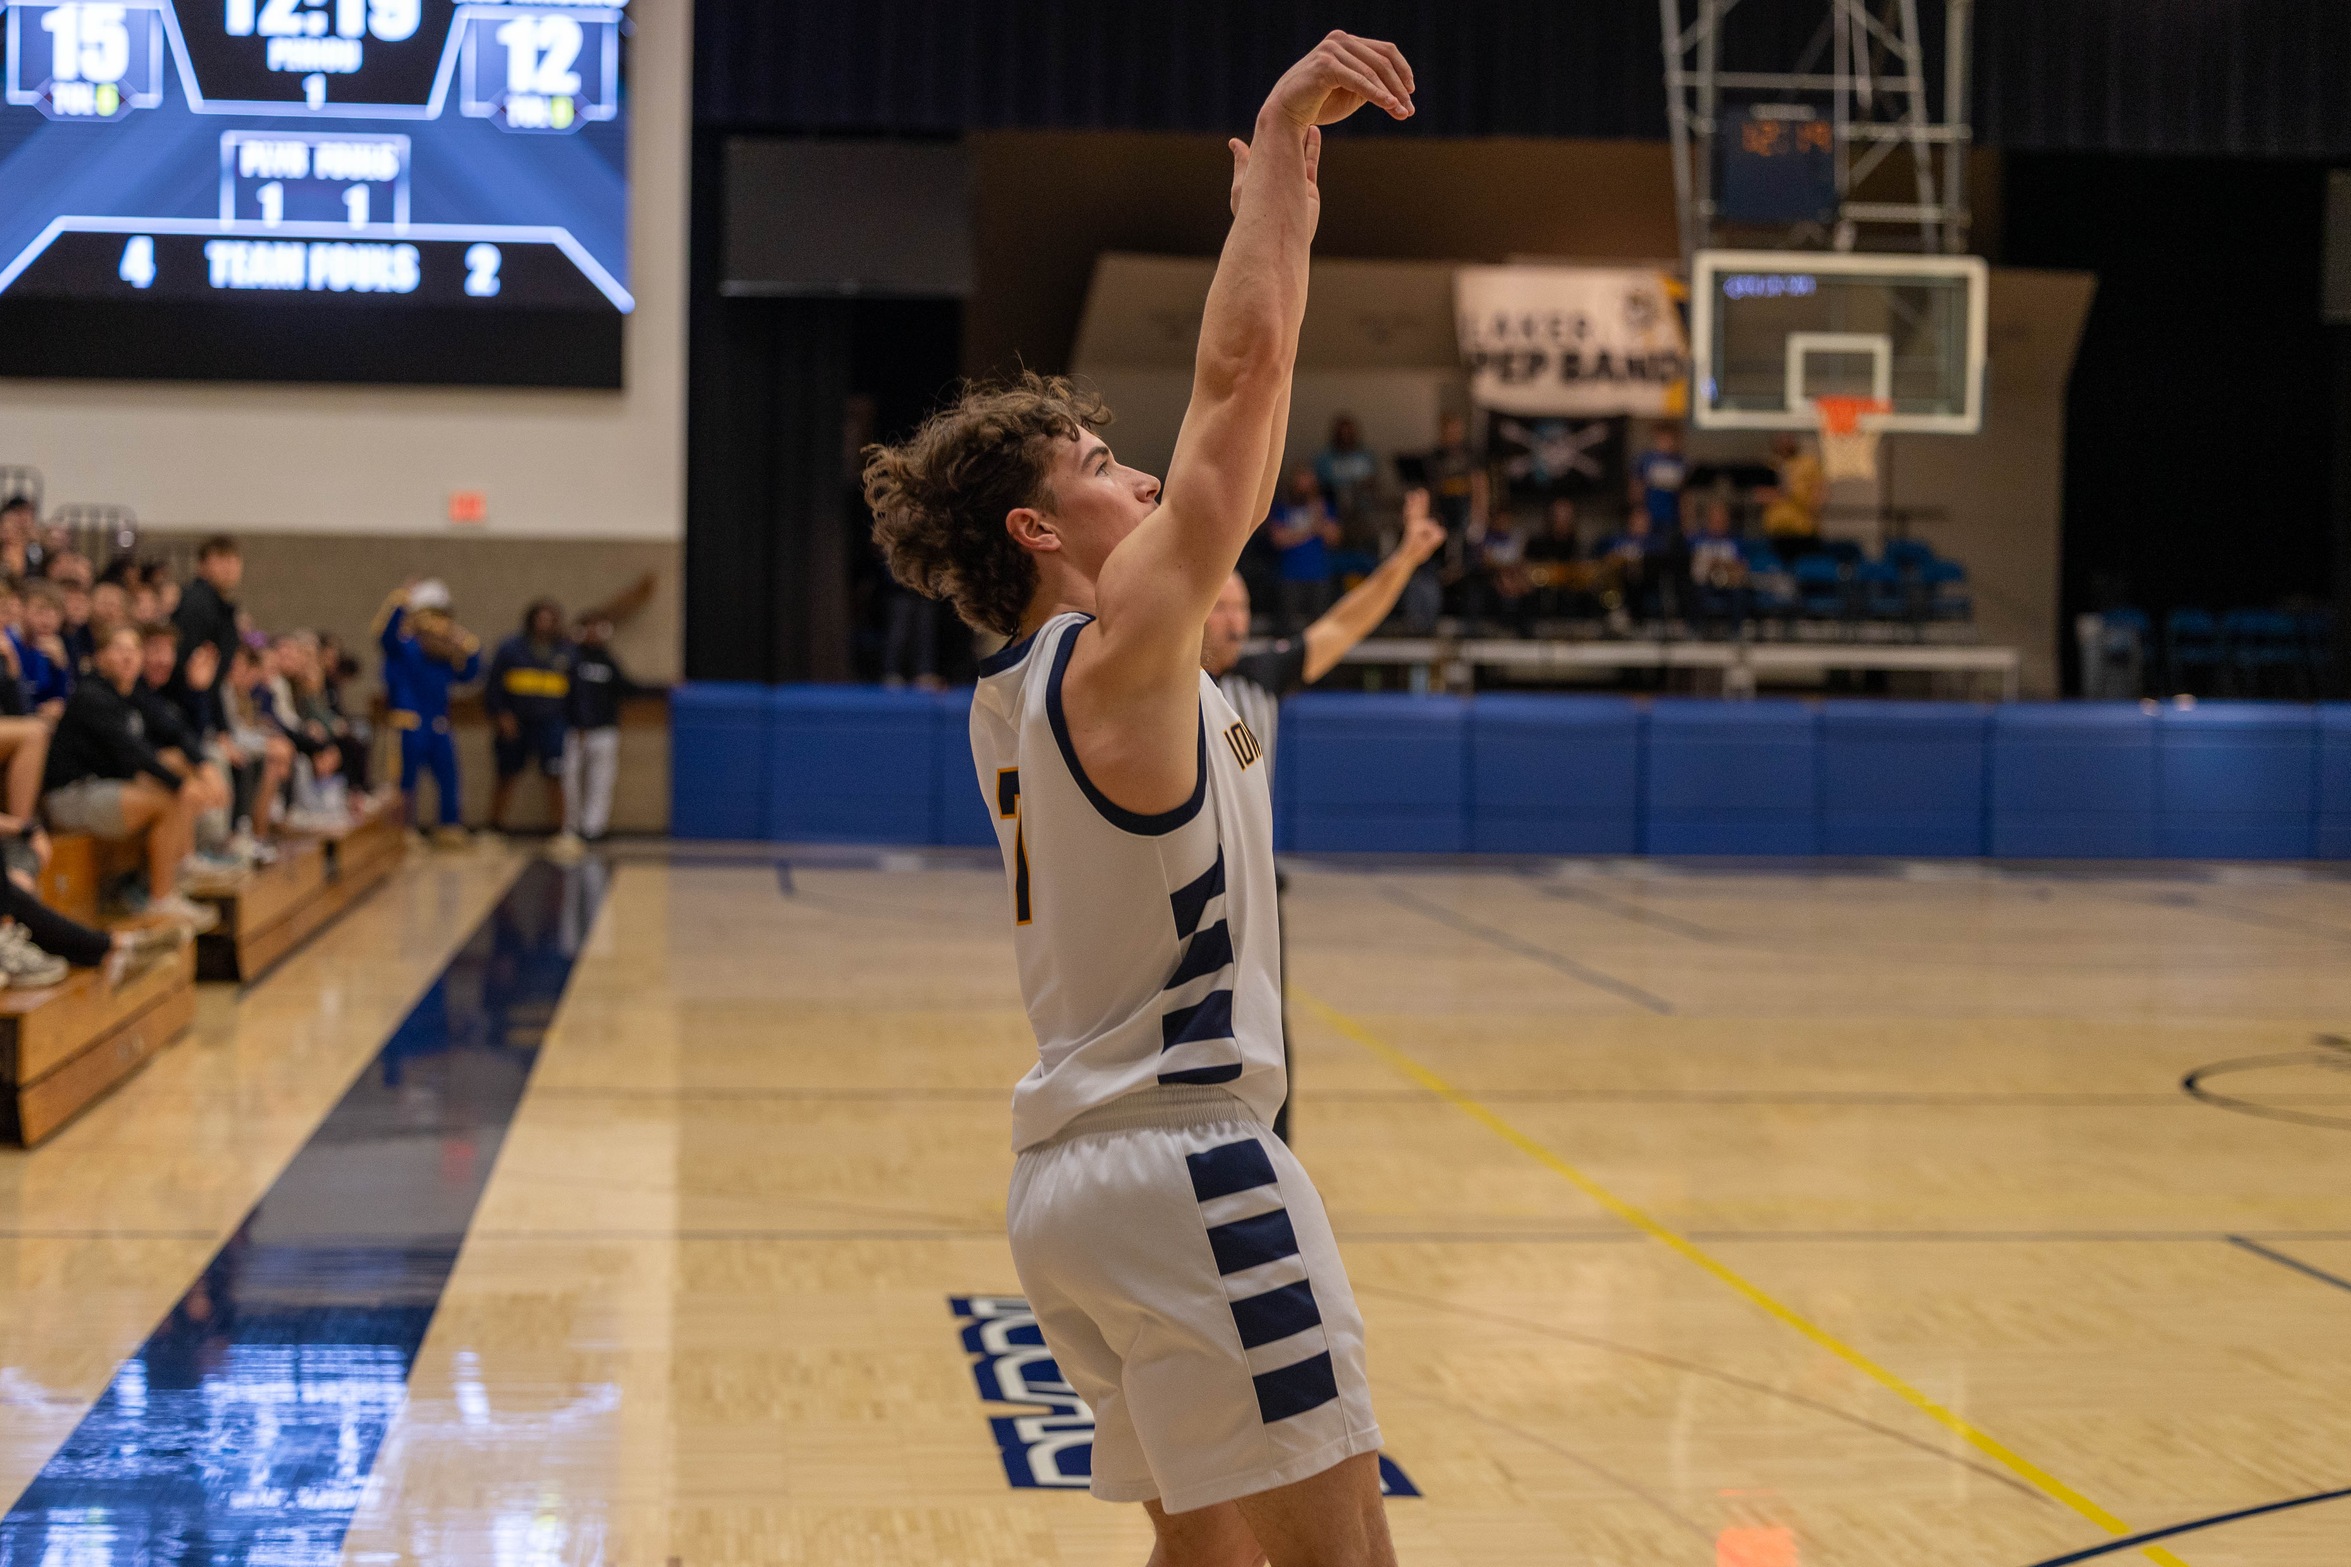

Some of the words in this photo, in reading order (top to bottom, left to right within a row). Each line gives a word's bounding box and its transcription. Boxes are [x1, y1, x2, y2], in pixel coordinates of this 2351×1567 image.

[41, 2, 130, 82] 15
[496, 14, 584, 94] 12
[302, 73, 327, 110] 1
[256, 181, 284, 229] 1
[342, 183, 370, 231] 1
[119, 235, 156, 288] 4
[464, 242, 501, 297] 2
